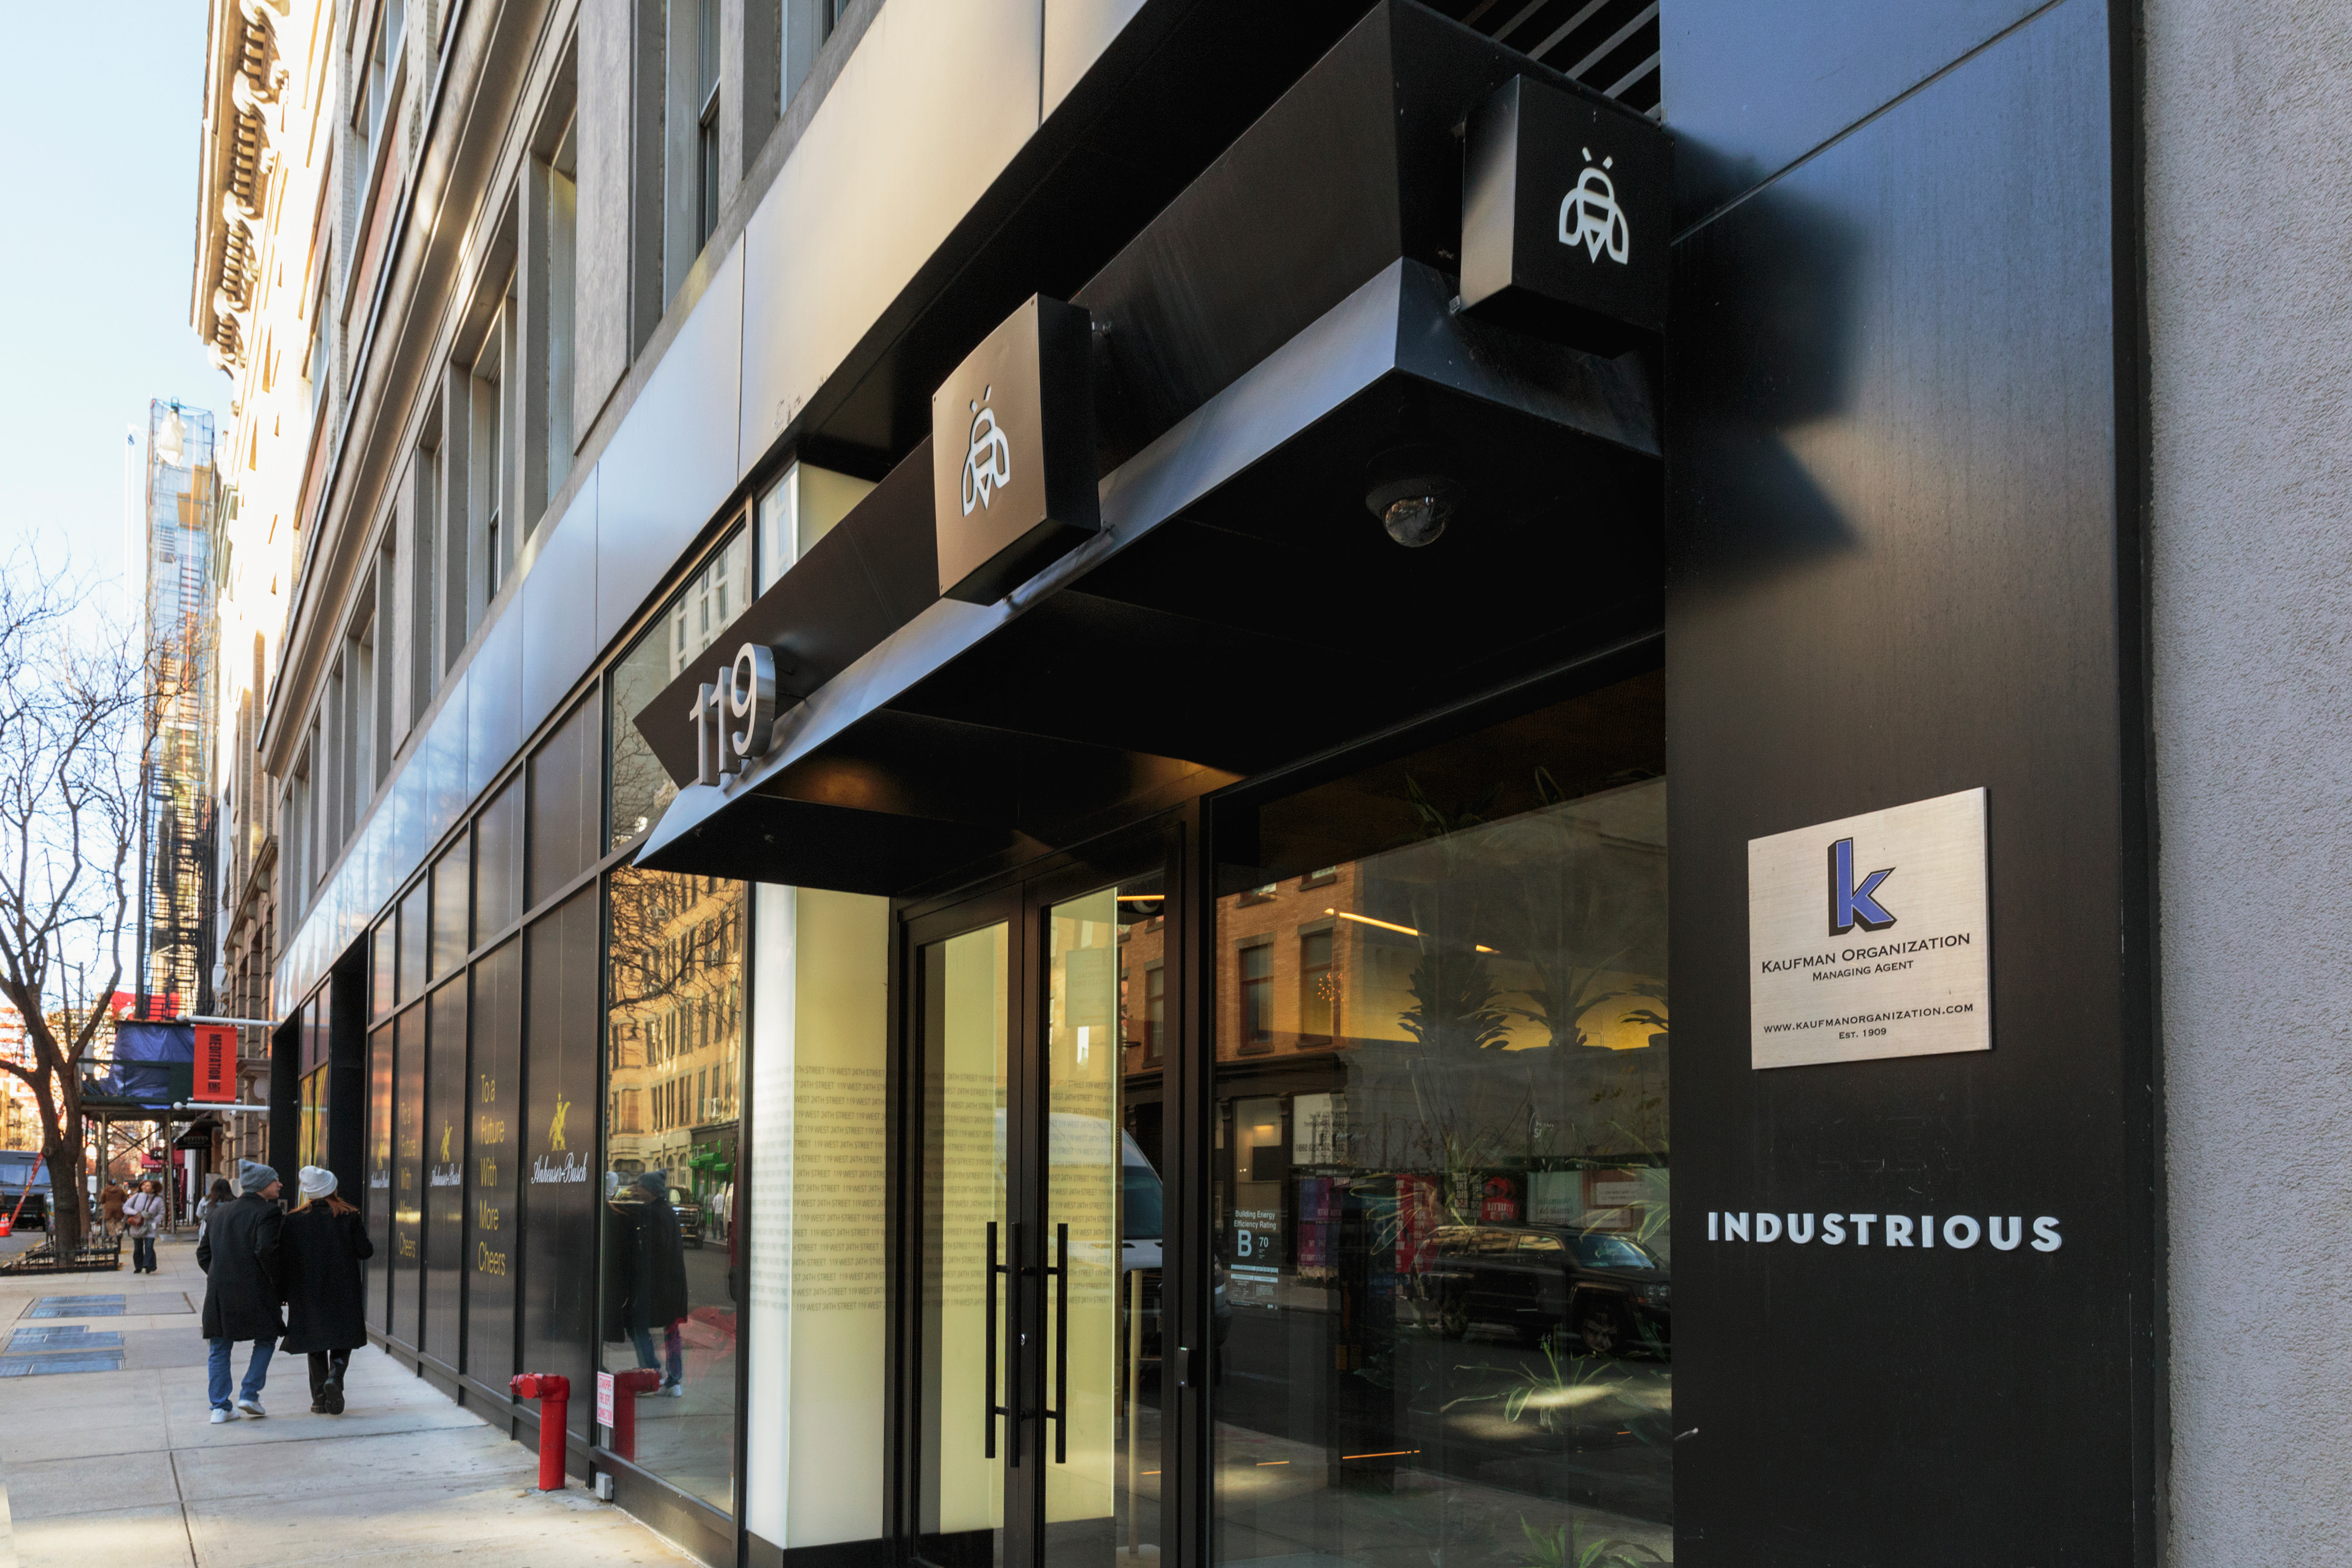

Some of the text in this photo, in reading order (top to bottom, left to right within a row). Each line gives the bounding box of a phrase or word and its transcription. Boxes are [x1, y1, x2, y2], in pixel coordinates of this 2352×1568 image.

[690, 642, 776, 786] 119
[1762, 932, 1971, 974] KAUFMAN ORGANIZATION
[1813, 960, 1914, 982] MANAGING AGENT
[1763, 1003, 1973, 1034] WWW.KAUFMANORGANIZATION.COM
[1862, 1028, 1887, 1037] 1909
[209, 1034, 222, 1080] MEDITATION
[481, 1074, 495, 1103] To a
[481, 1116, 504, 1145] Future
[481, 1156, 497, 1187] With
[531, 1152, 588, 1184] Anheuser-Busch
[480, 1199, 498, 1230] More
[1234, 1220, 1276, 1230] Efficiency Rating
[1235, 1210, 1275, 1220] Building Energy
[1238, 1229, 1252, 1257] B
[1259, 1237, 1268, 1248] 70
[1708, 1212, 2062, 1252] INDUSTRIOUS
[478, 1241, 505, 1276] Cheers
